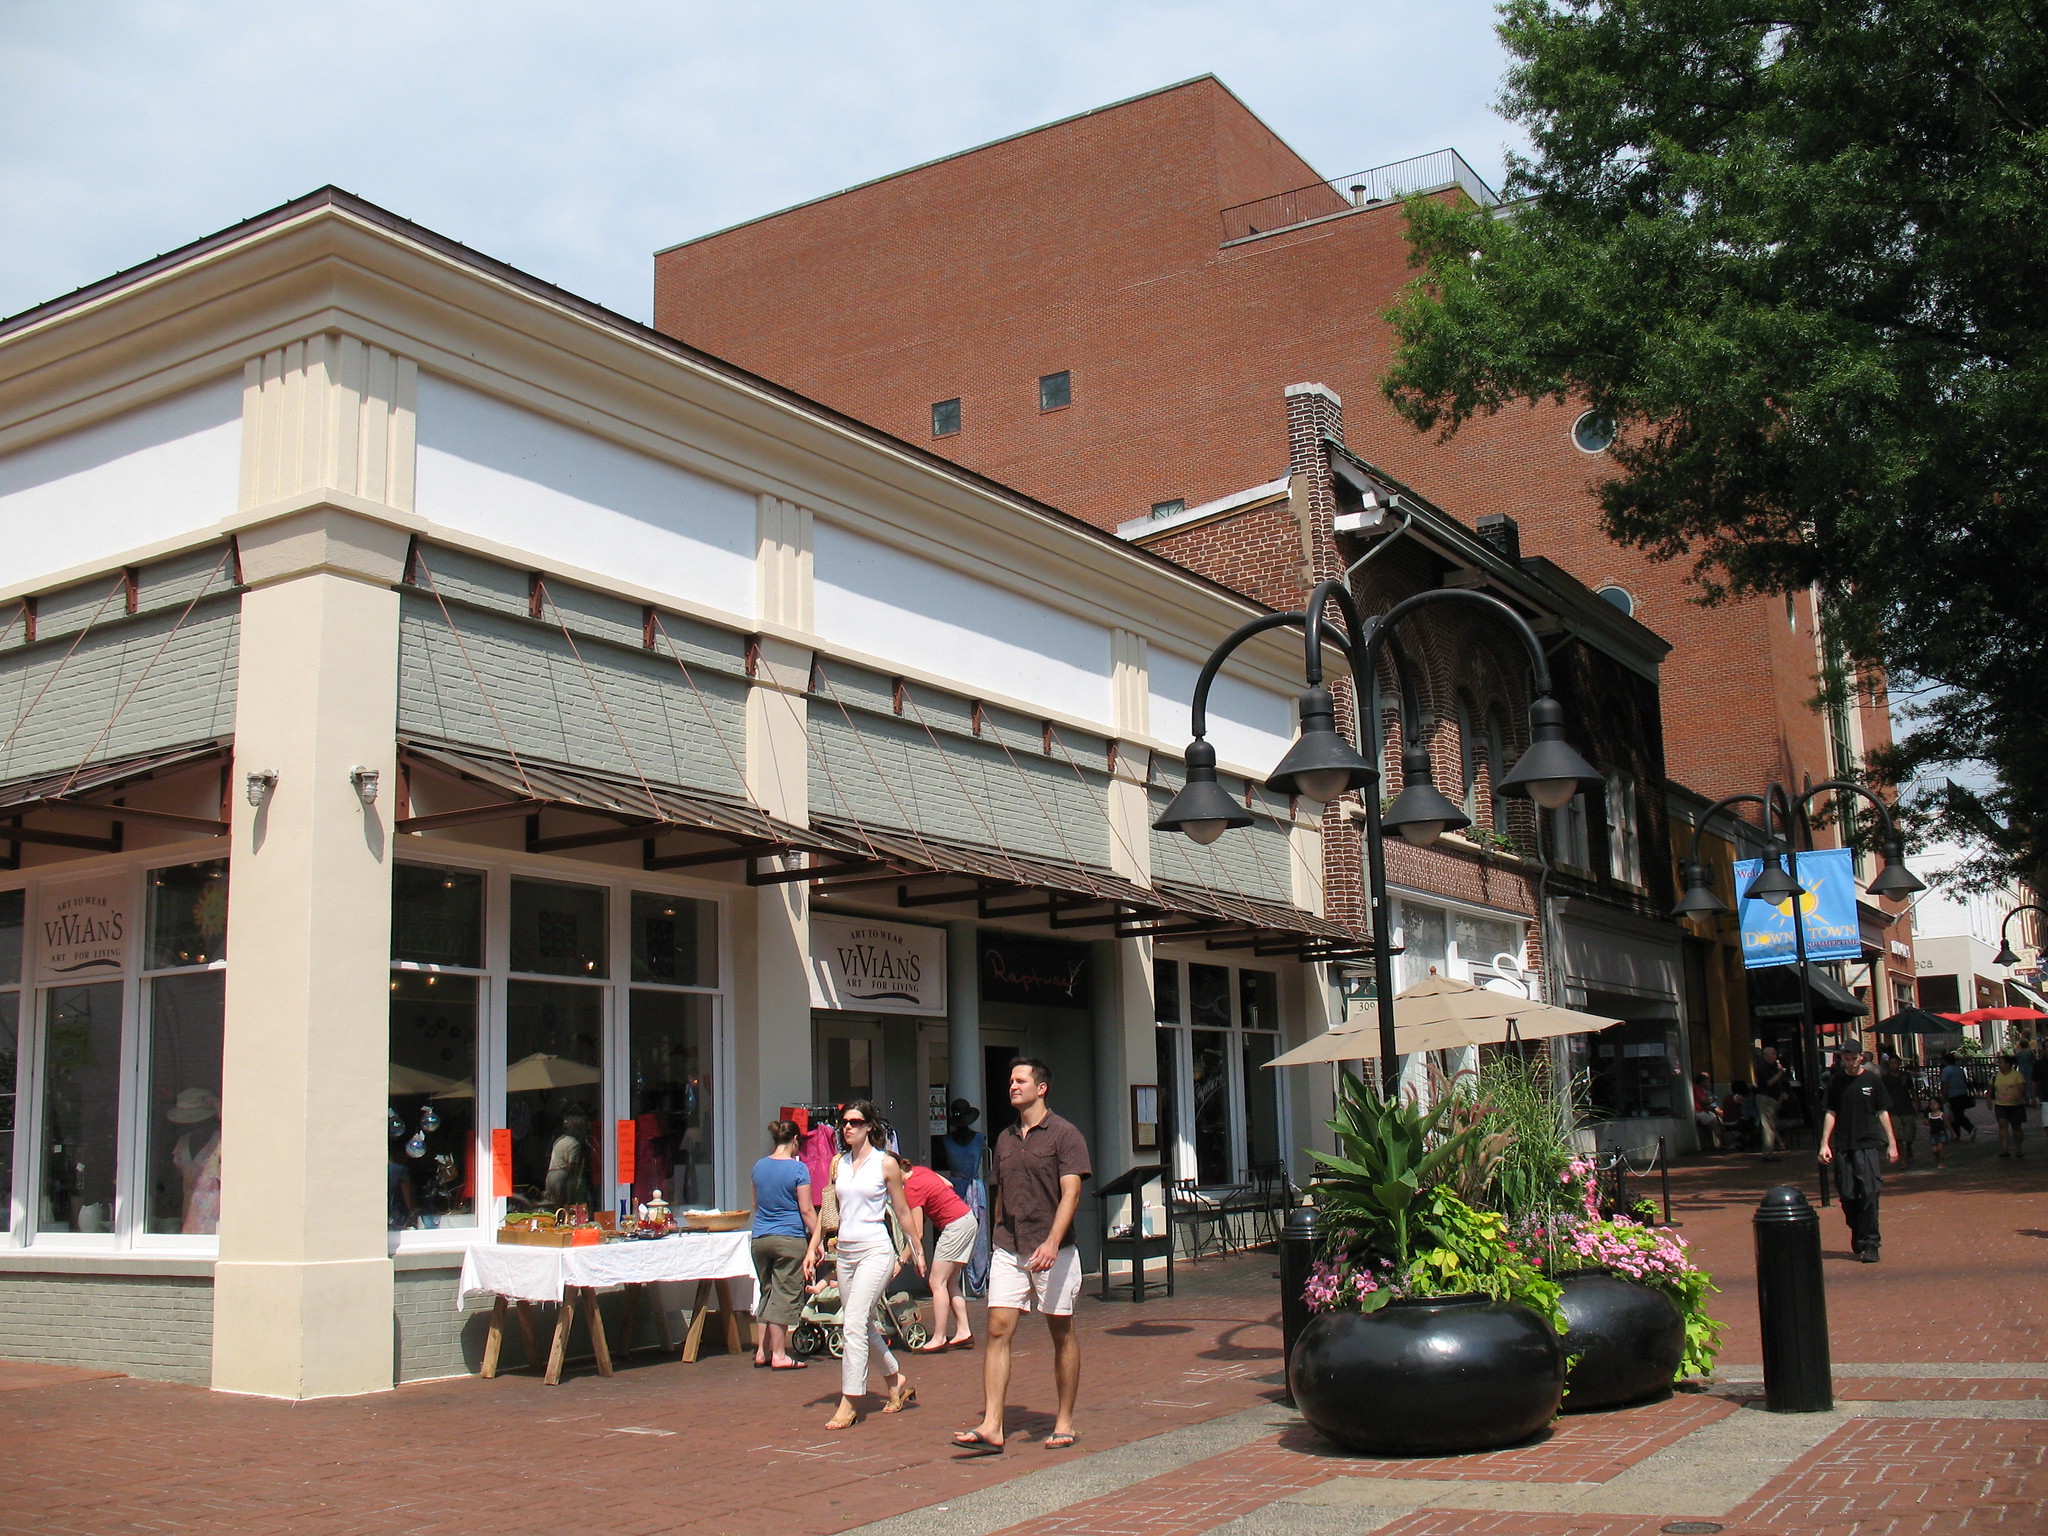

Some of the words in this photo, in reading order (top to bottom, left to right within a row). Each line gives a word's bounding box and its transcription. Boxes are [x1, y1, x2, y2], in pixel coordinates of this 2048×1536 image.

[1736, 868, 1762, 879] Welc
[56, 900, 71, 911] ART
[74, 898, 84, 907] TO
[85, 896, 107, 907] WEAR
[44, 910, 123, 947] VIVIAN'S
[1807, 924, 1857, 940] TOWN
[850, 930, 865, 940] ART
[868, 929, 879, 938] TO
[880, 930, 903, 945] WEAR
[1806, 938, 1859, 951] SUMMERTIME
[51, 953, 66, 962] ART
[74, 951, 90, 960] FOR
[94, 948, 121, 958] LIVING
[837, 944, 920, 982] VIVIAN'S
[846, 979, 862, 988] ART
[872, 980, 888, 990] FOR
[892, 982, 919, 993] LIVING
